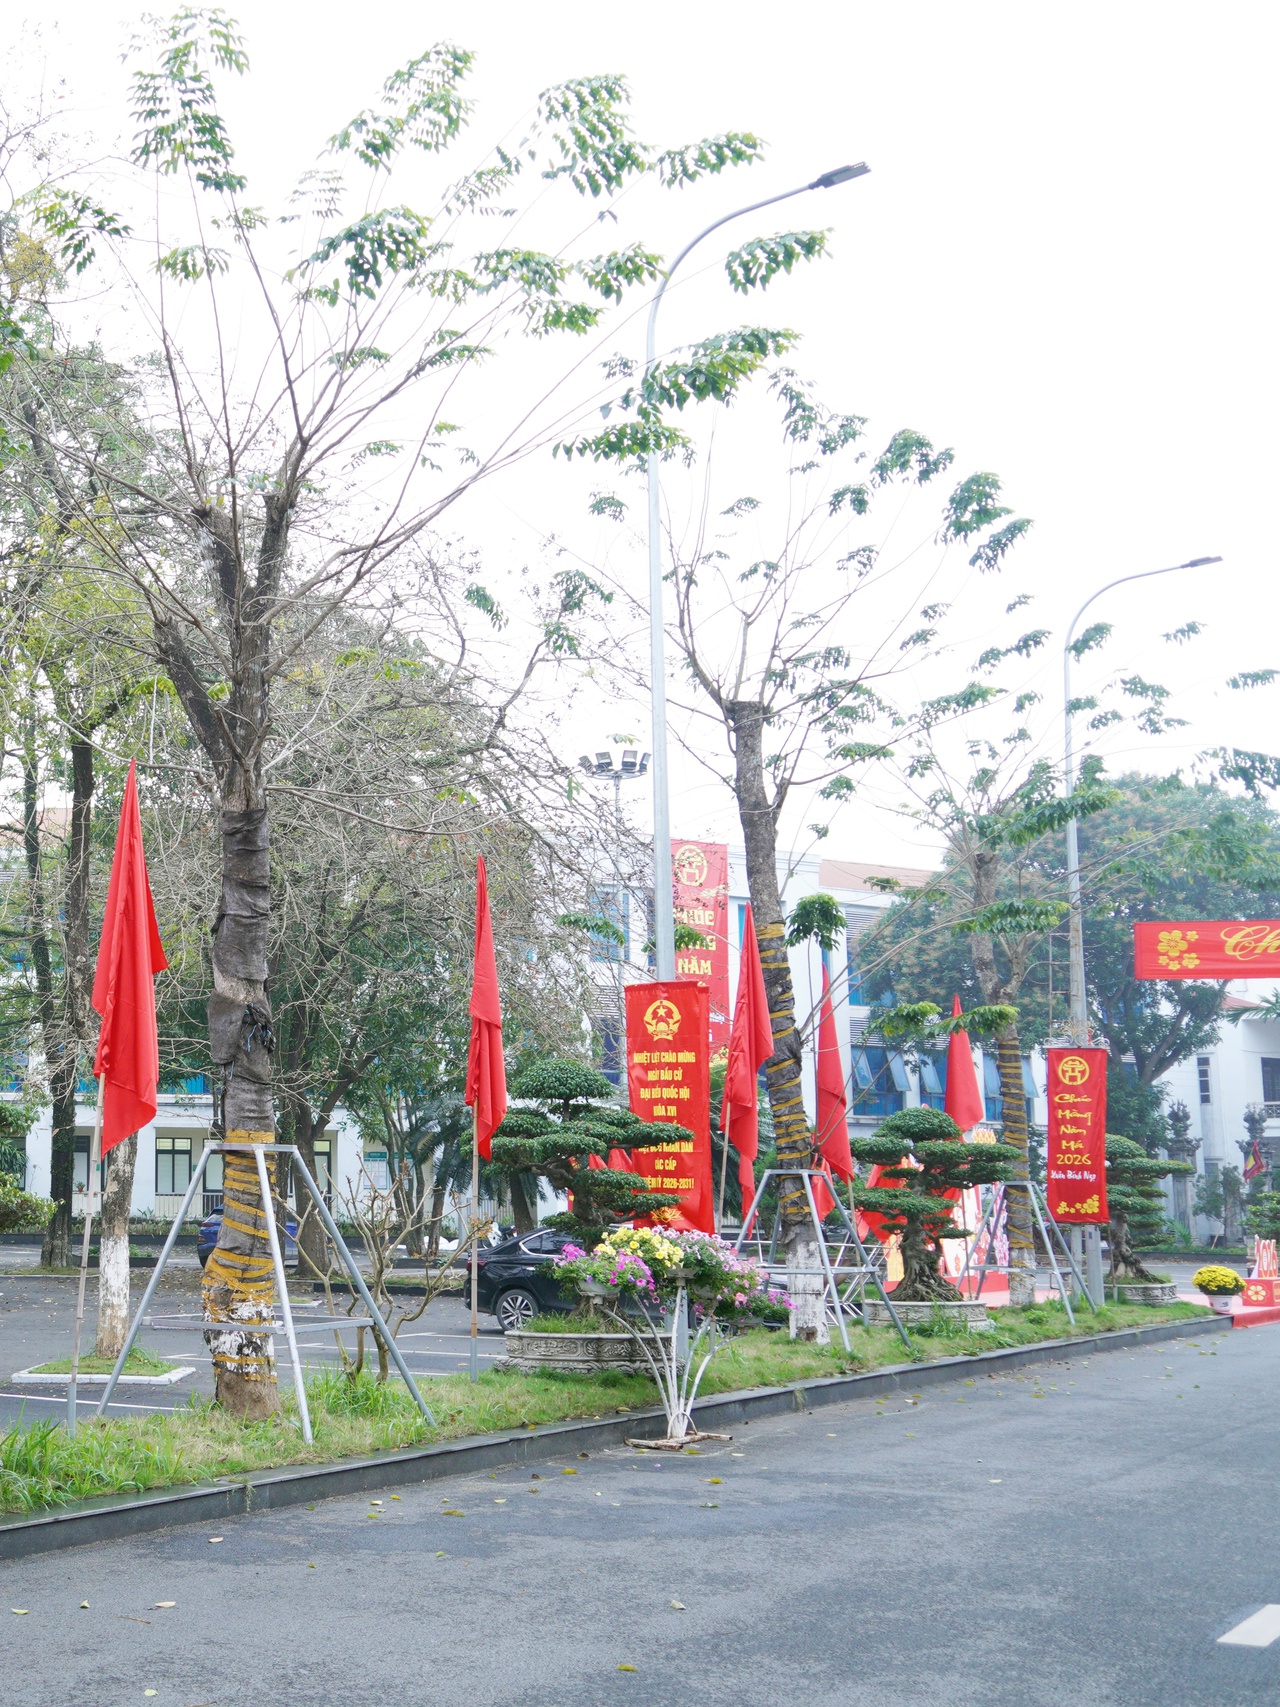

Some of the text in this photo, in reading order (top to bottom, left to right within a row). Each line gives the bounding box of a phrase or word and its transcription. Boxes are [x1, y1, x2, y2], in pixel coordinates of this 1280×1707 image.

[677, 955, 712, 976] NĂM
[661, 1084, 679, 1099] QUỐC
[679, 1086, 690, 1101] HỘI
[664, 1156, 677, 1171] CẤP
[1056, 1153, 1092, 1165] 2026
